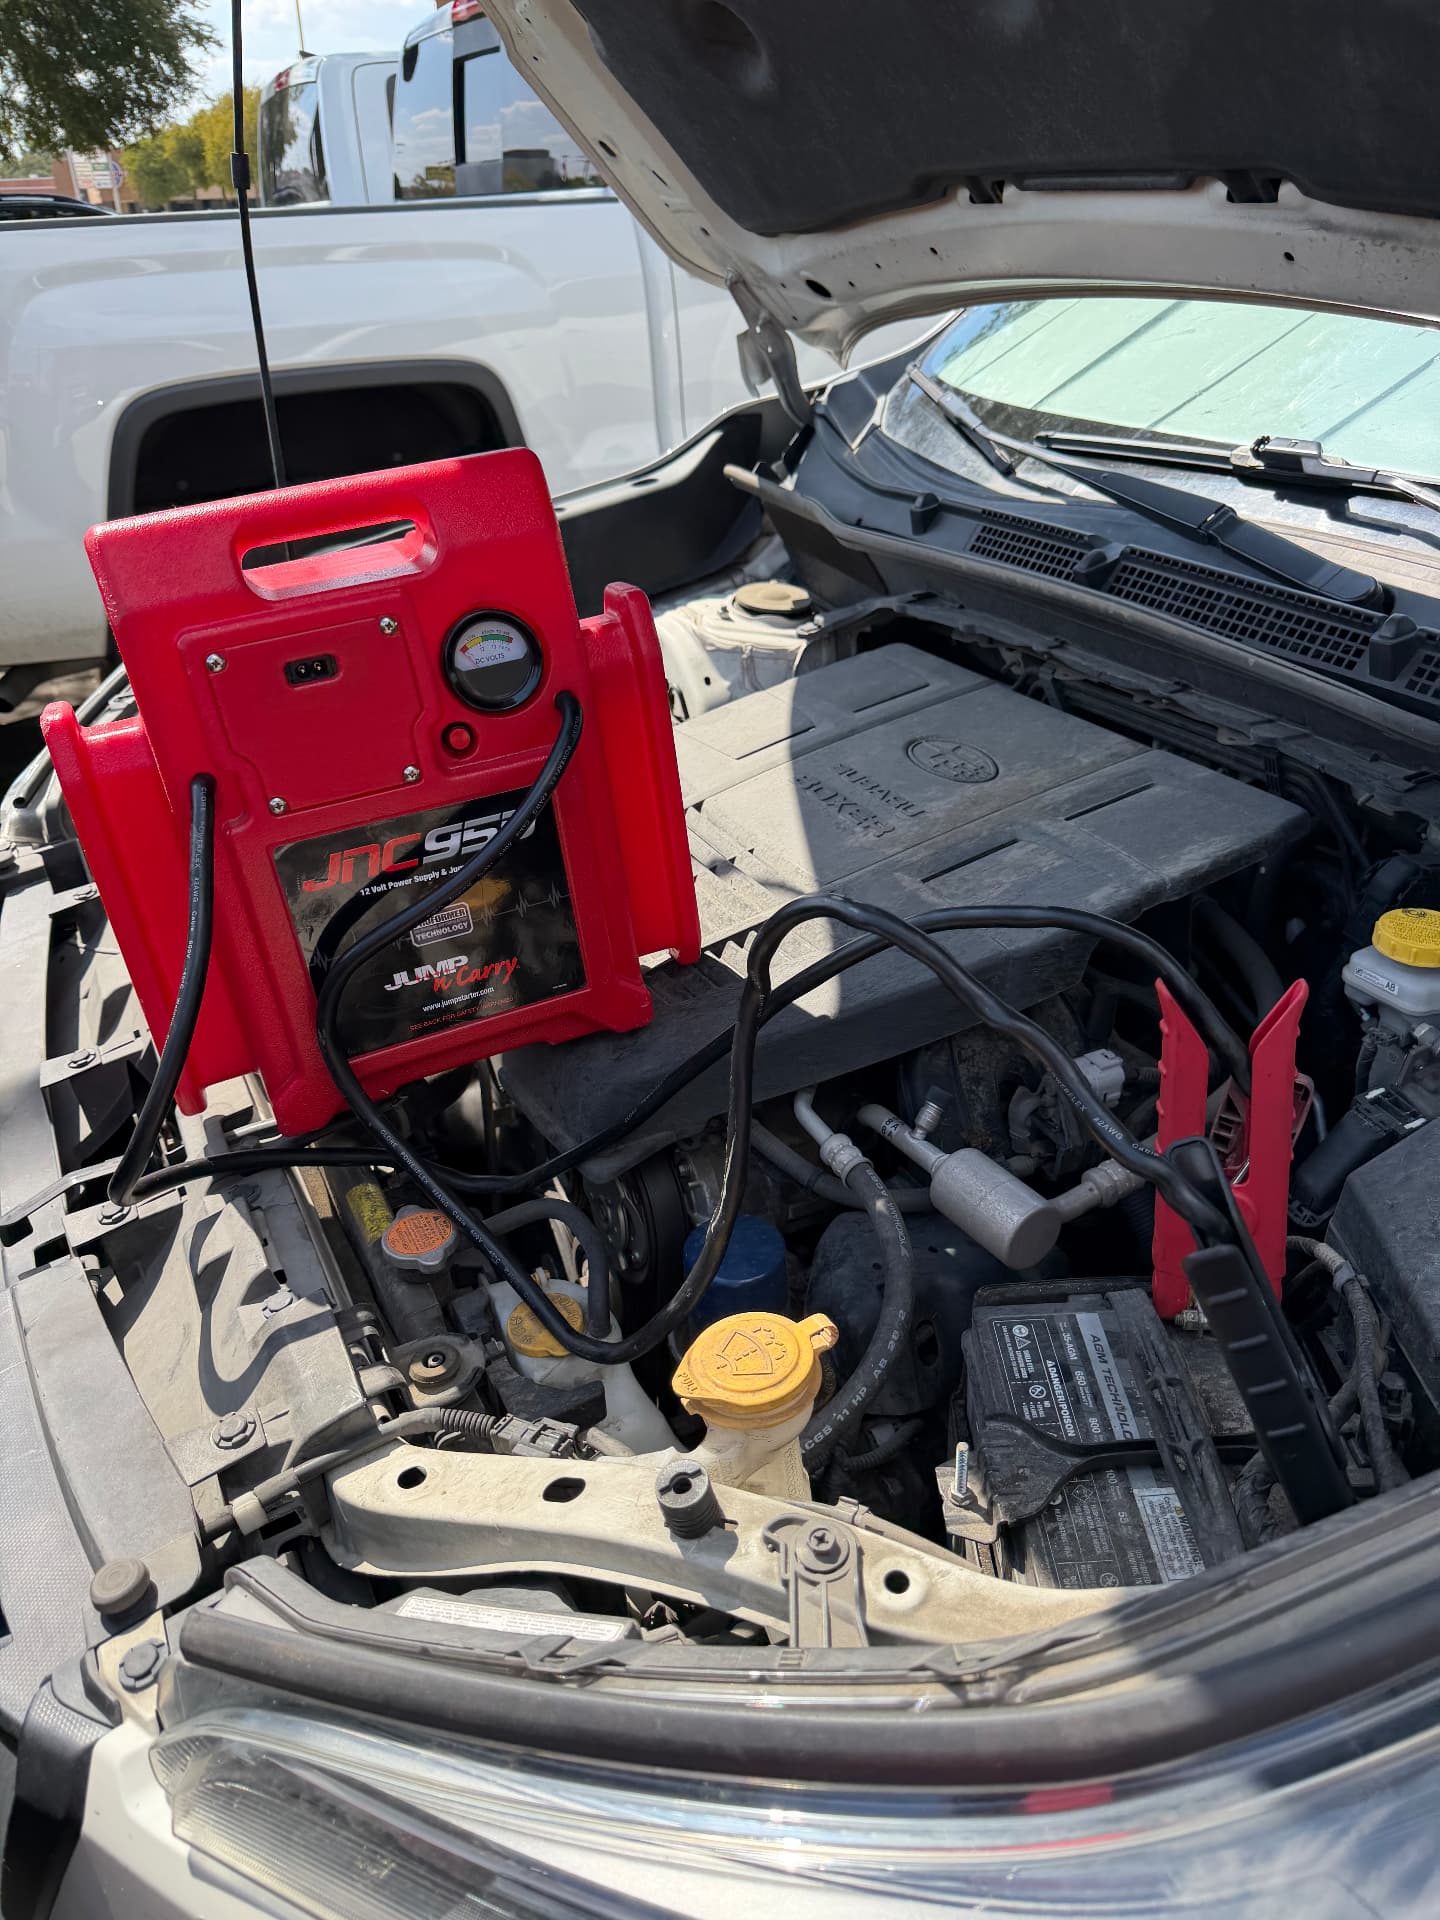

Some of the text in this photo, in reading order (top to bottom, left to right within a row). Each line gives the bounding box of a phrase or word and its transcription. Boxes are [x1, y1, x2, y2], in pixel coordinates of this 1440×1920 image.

[475, 653, 505, 665] DC VOLTS
[834, 763, 928, 819] SUBARU
[359, 888, 372, 897] 12
[370, 883, 388, 894] Volt
[388, 877, 413, 890] Power
[413, 870, 440, 883] Supply
[440, 868, 448, 876] &
[415, 921, 469, 941] TECHNOLOGY
[384, 955, 469, 991] JUMP
[455, 956, 519, 985] Carry
[422, 986, 495, 1013] www.jumpstarter.com
[400, 1151, 430, 1185] POWERFLEX
[1090, 1334, 1108, 1365] AGM
[1074, 1370, 1087, 1387] 650
[1049, 1366, 1076, 1437] DANGER/POISON
[1105, 1469, 1118, 1484] 100
